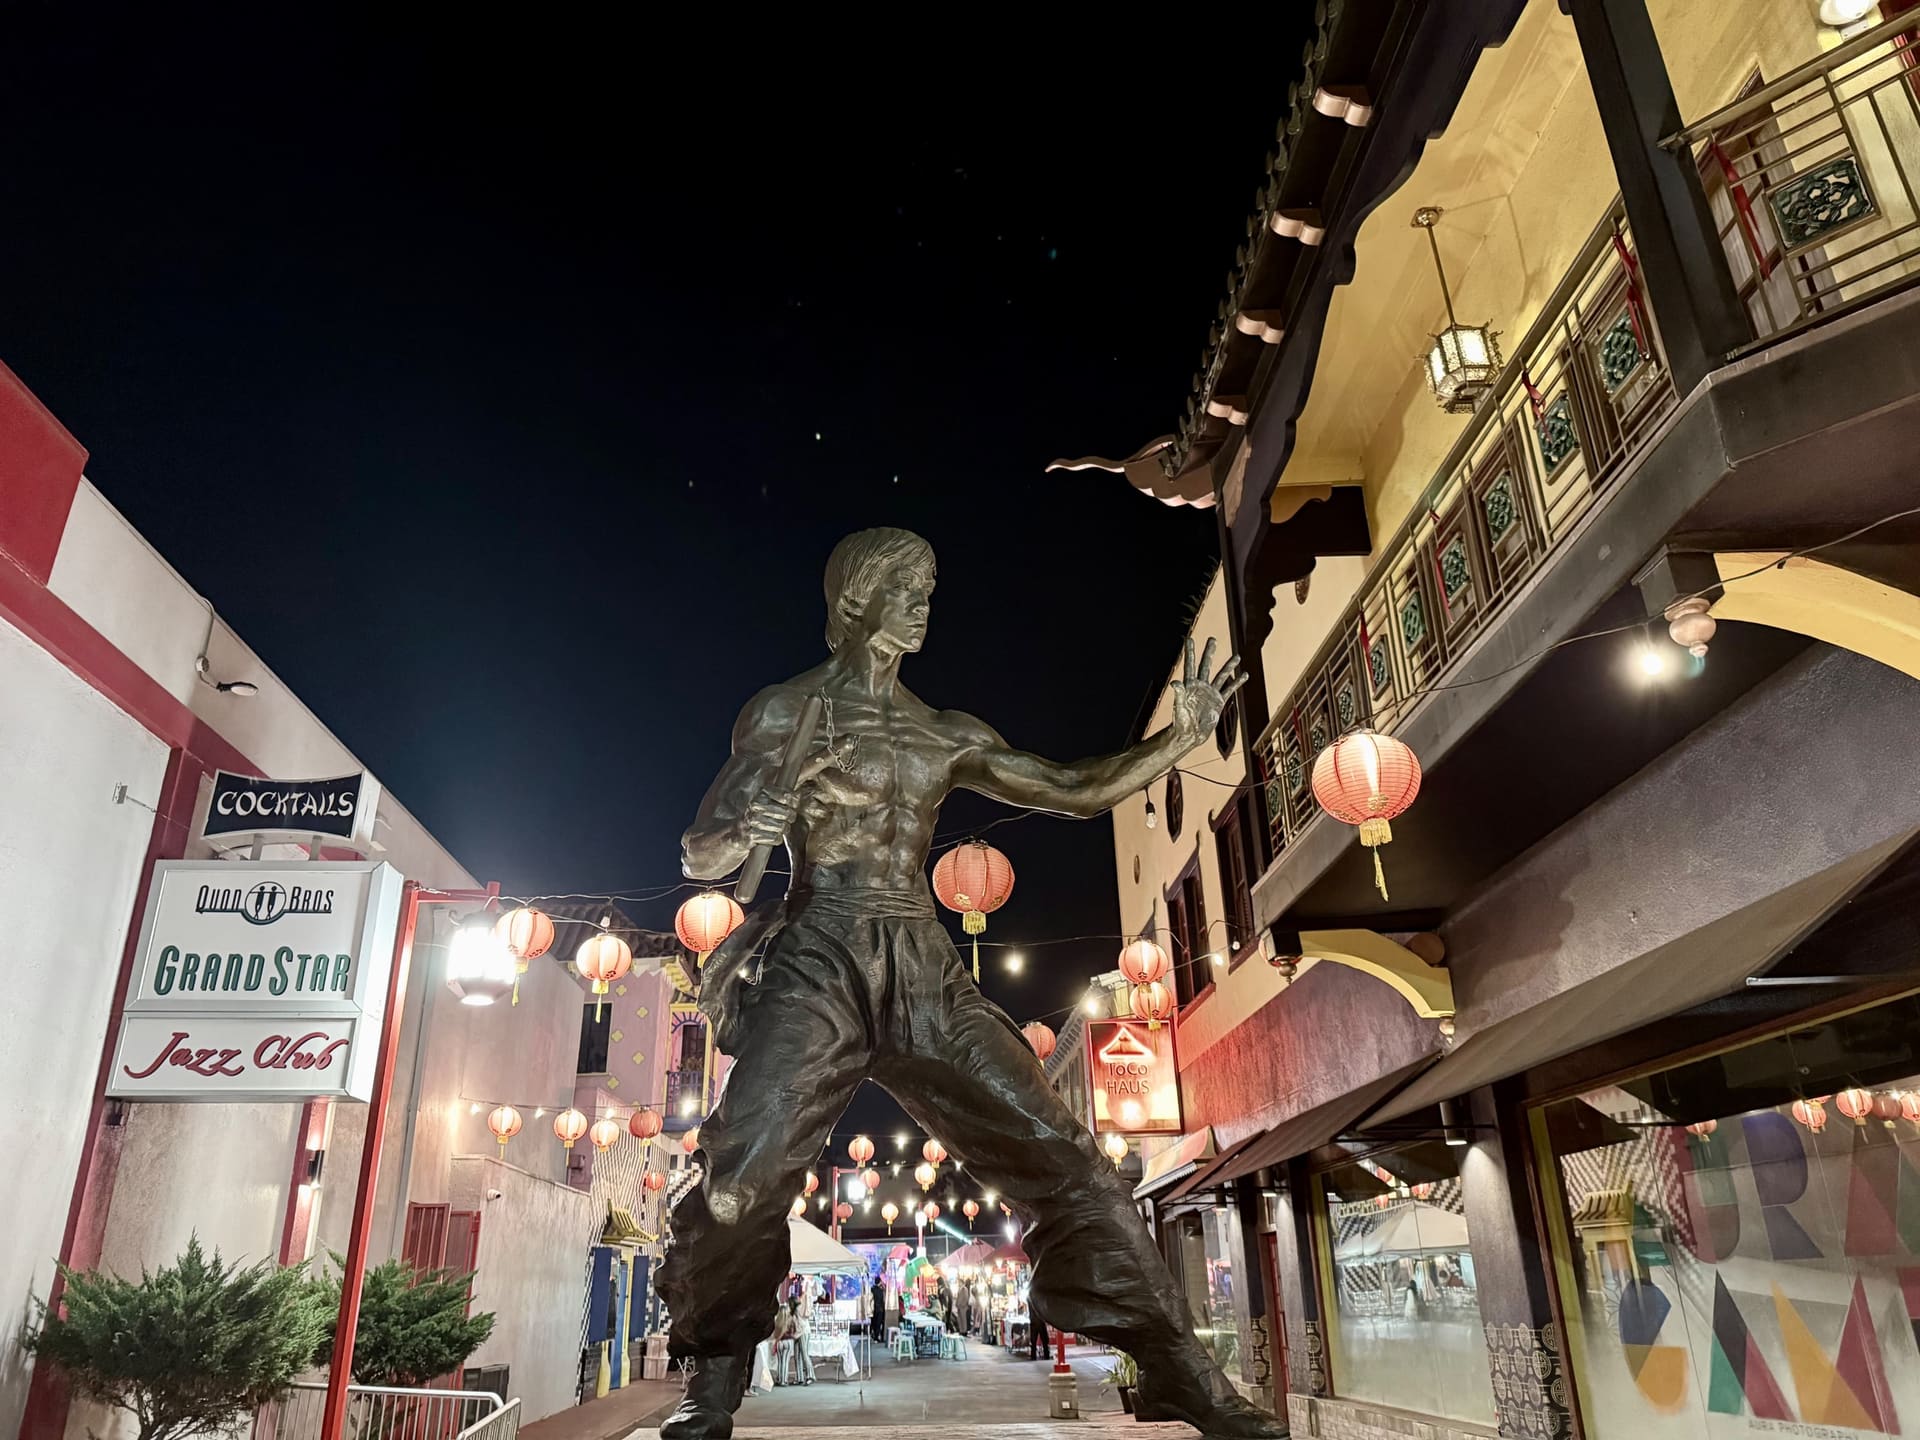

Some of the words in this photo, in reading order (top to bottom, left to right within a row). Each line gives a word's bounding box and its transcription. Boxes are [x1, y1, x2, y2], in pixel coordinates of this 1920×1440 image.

[217, 790, 354, 817] COCKTAILS
[289, 886, 335, 913] BROS
[154, 945, 265, 996] GRAND
[268, 945, 351, 996] STAR
[123, 1032, 245, 1079] Jazz
[253, 1031, 349, 1071] Club
[1106, 1080, 1150, 1095] HAUS
